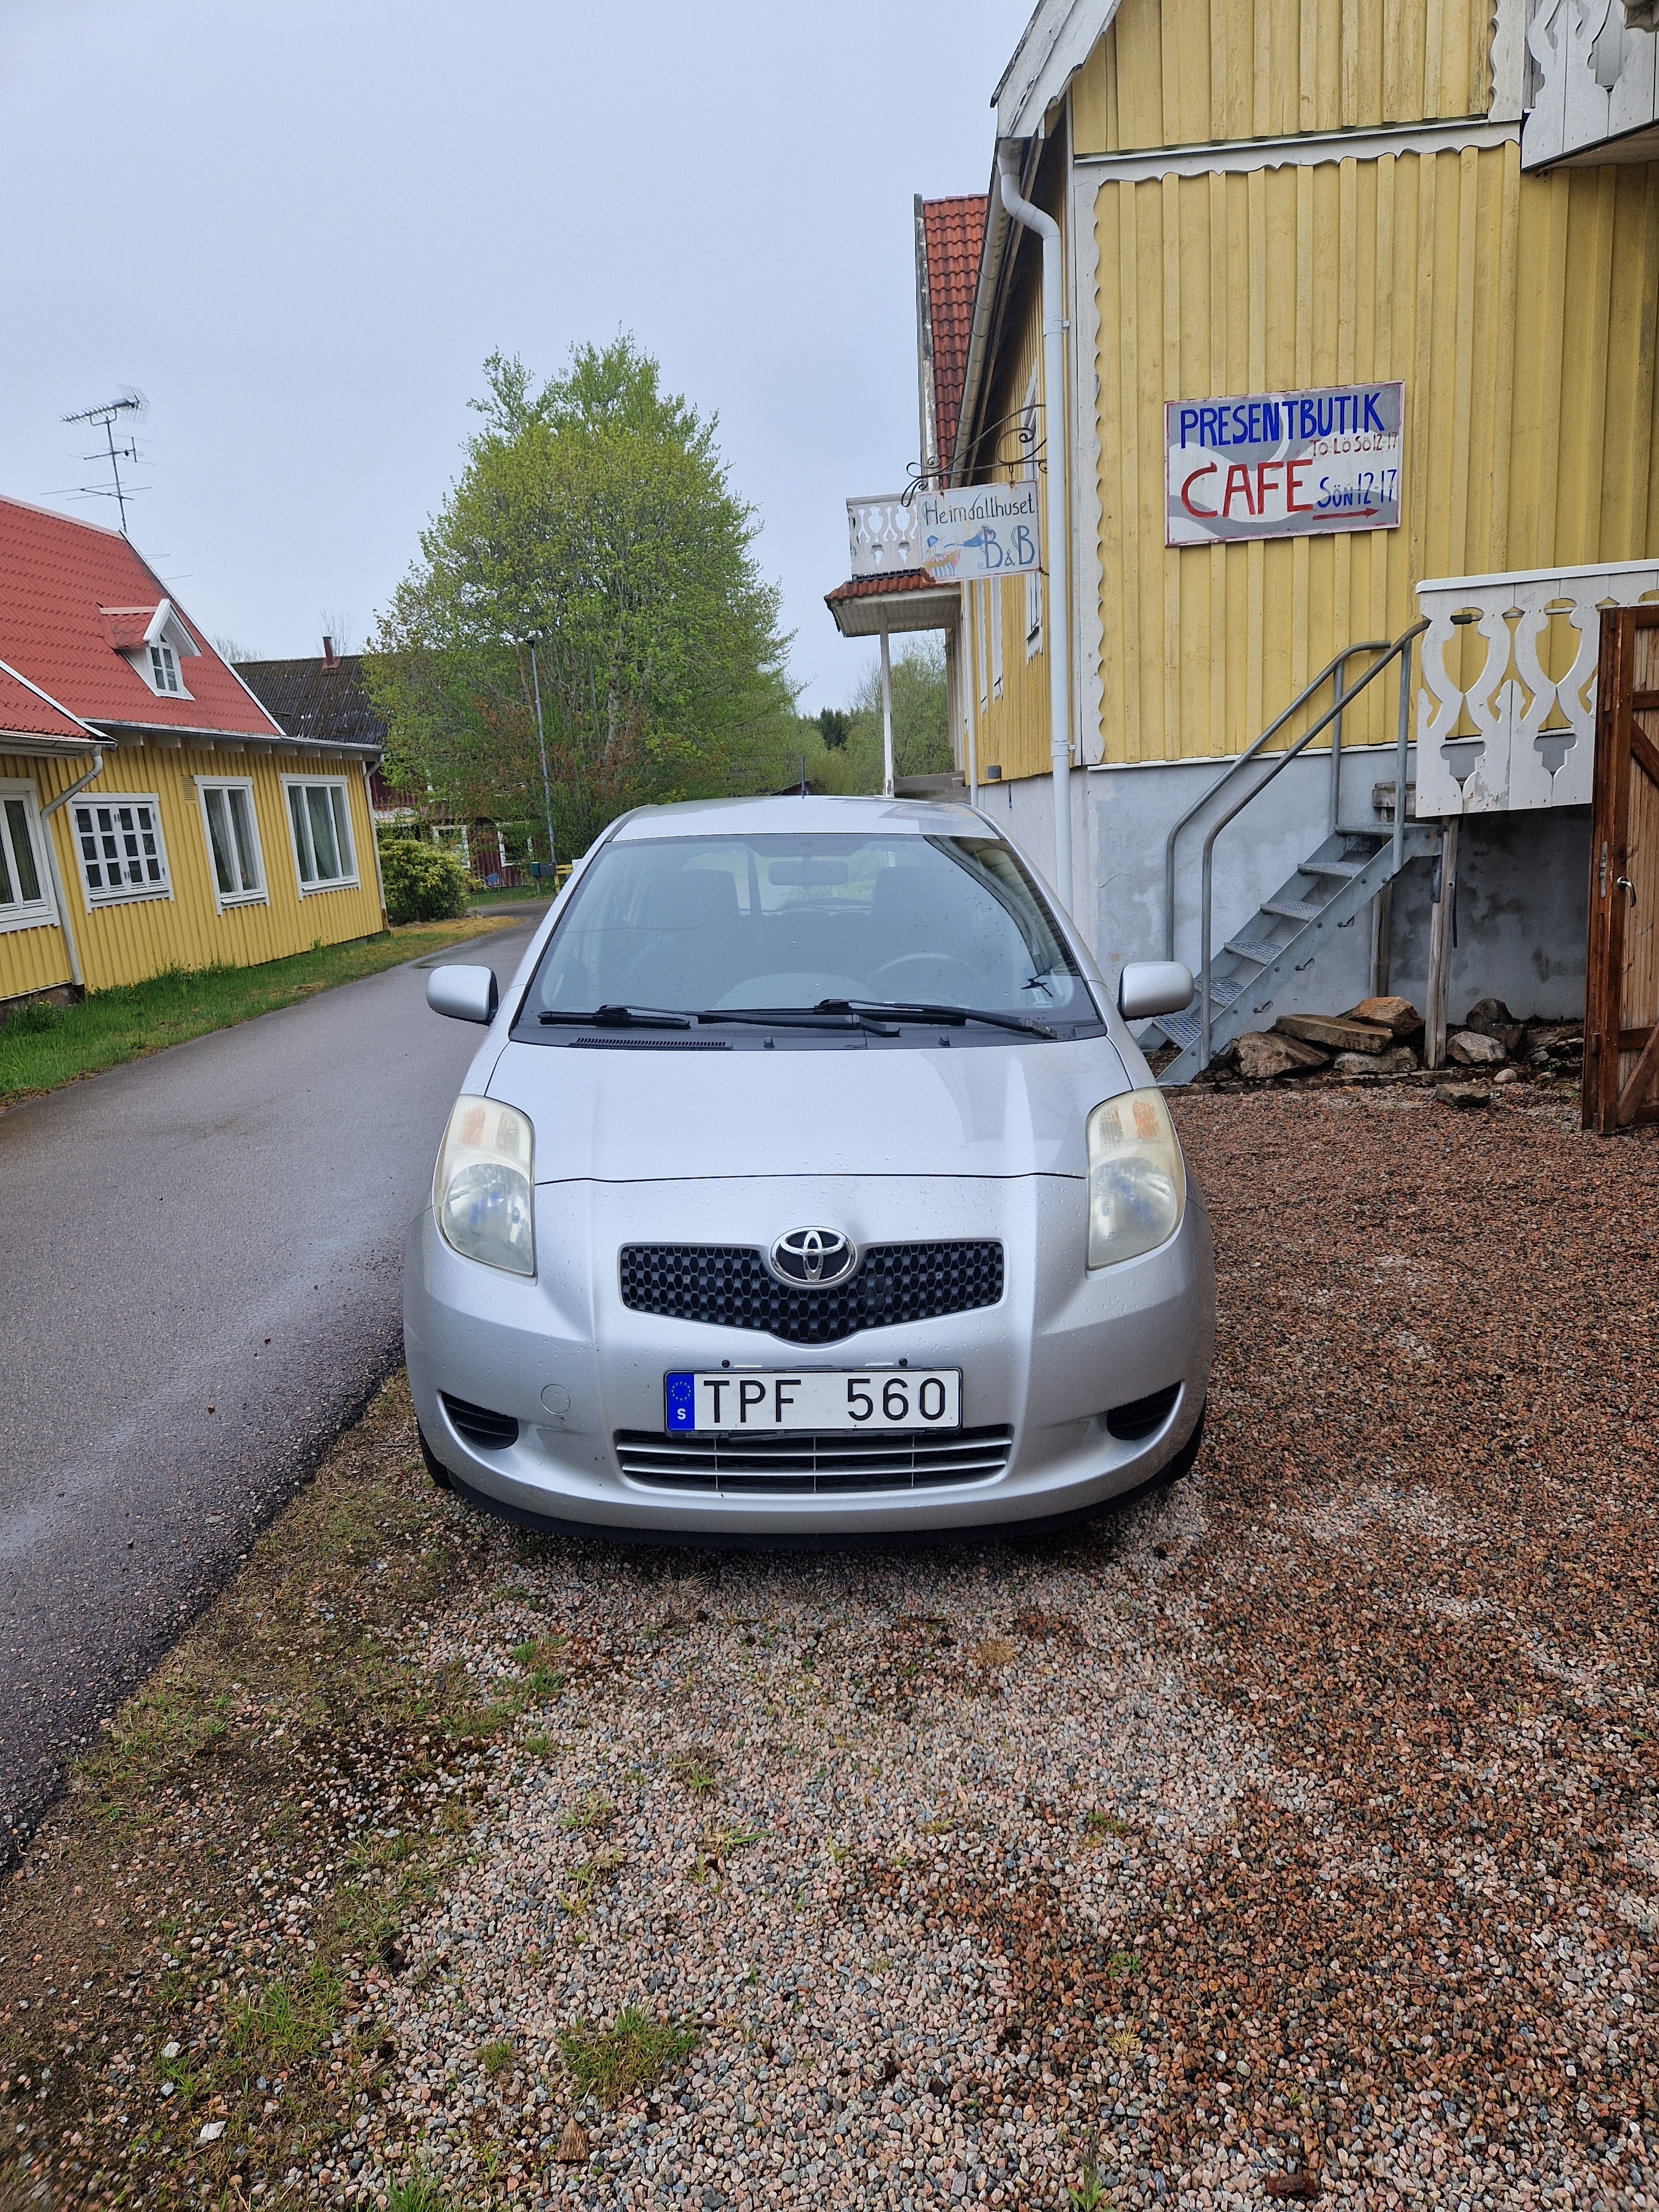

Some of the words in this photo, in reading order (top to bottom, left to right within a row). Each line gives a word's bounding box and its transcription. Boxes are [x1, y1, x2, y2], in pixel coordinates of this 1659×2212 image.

[1181, 392, 1385, 449] PRESENTBUTIK
[1181, 459, 1313, 518] CAFE
[1358, 469, 1397, 504] 12-17
[922, 492, 1035, 525] Heimdallhuset
[677, 1408, 686, 1420] S
[703, 1379, 801, 1423] TPF
[847, 1377, 946, 1421] 560
